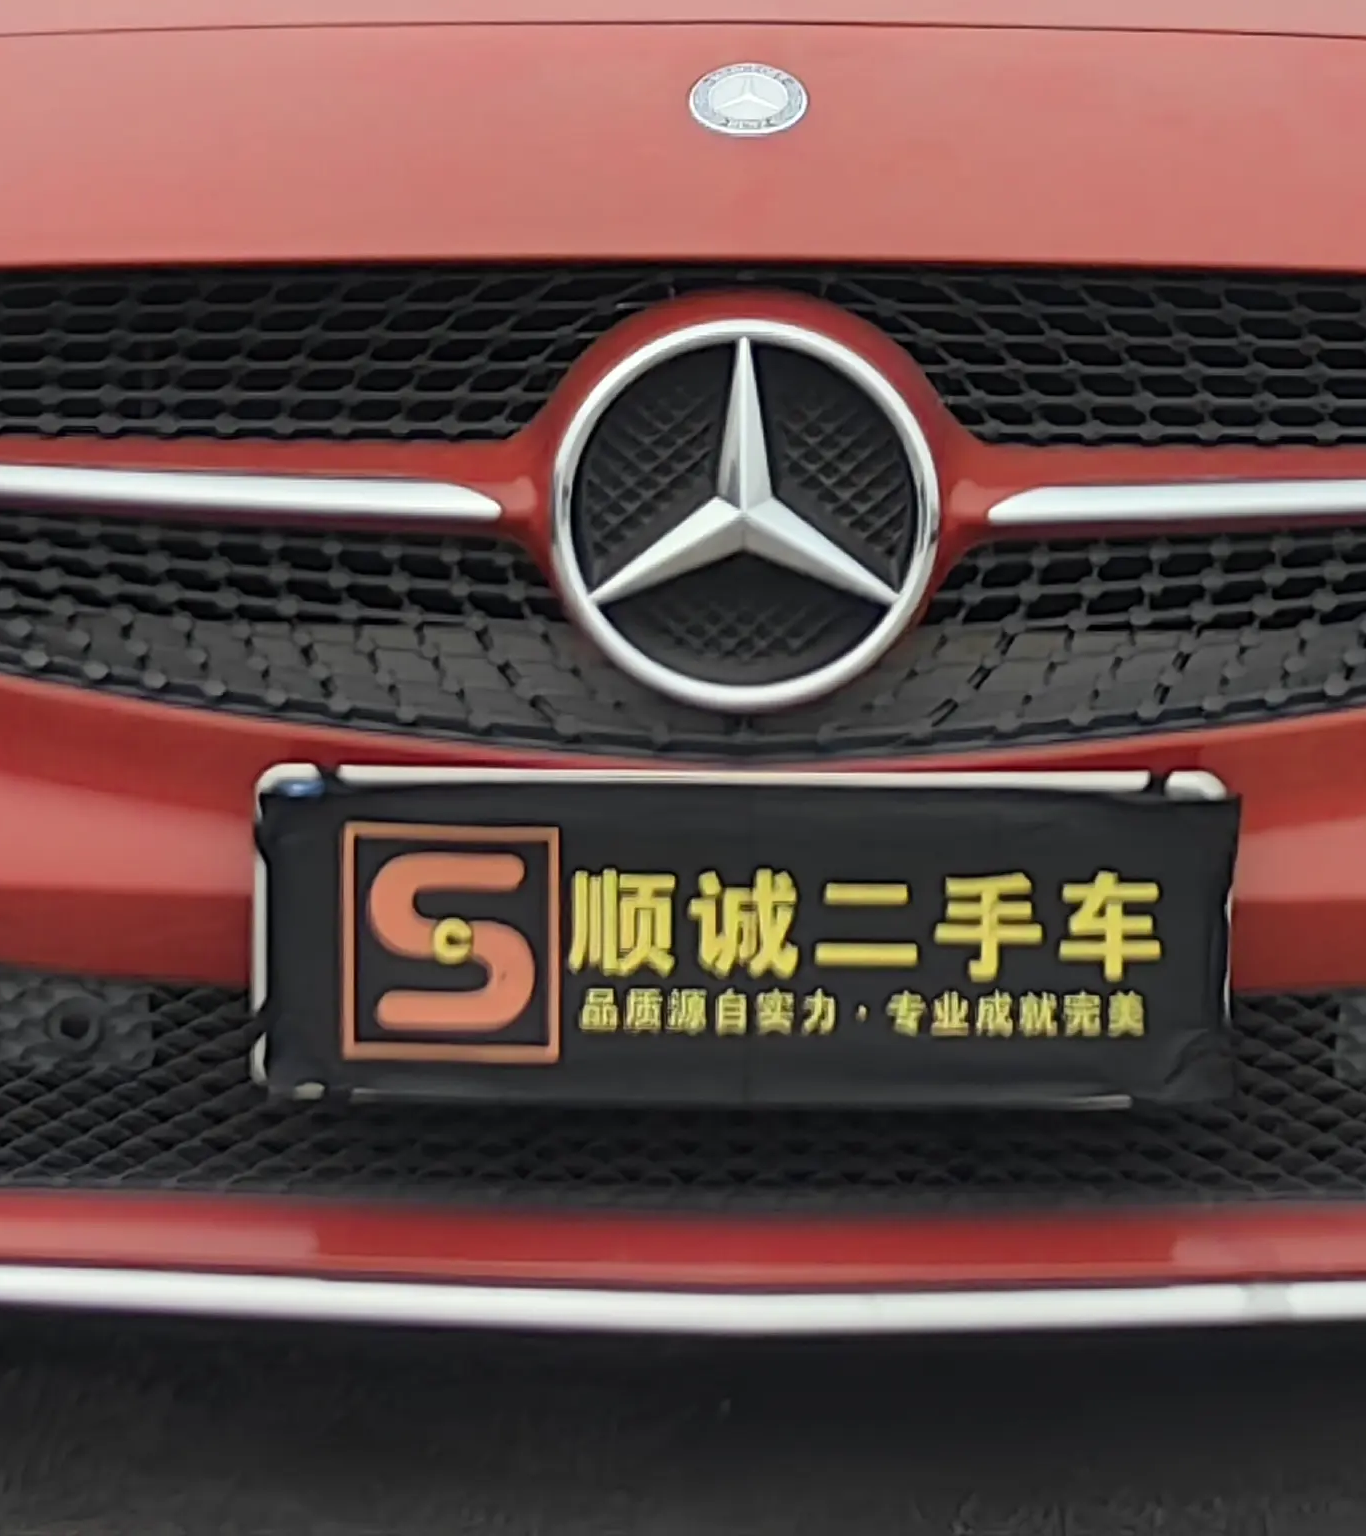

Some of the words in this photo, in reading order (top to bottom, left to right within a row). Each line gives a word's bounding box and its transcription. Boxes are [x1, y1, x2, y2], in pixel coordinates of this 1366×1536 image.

[569, 868, 1162, 982] 顺诚二手车
